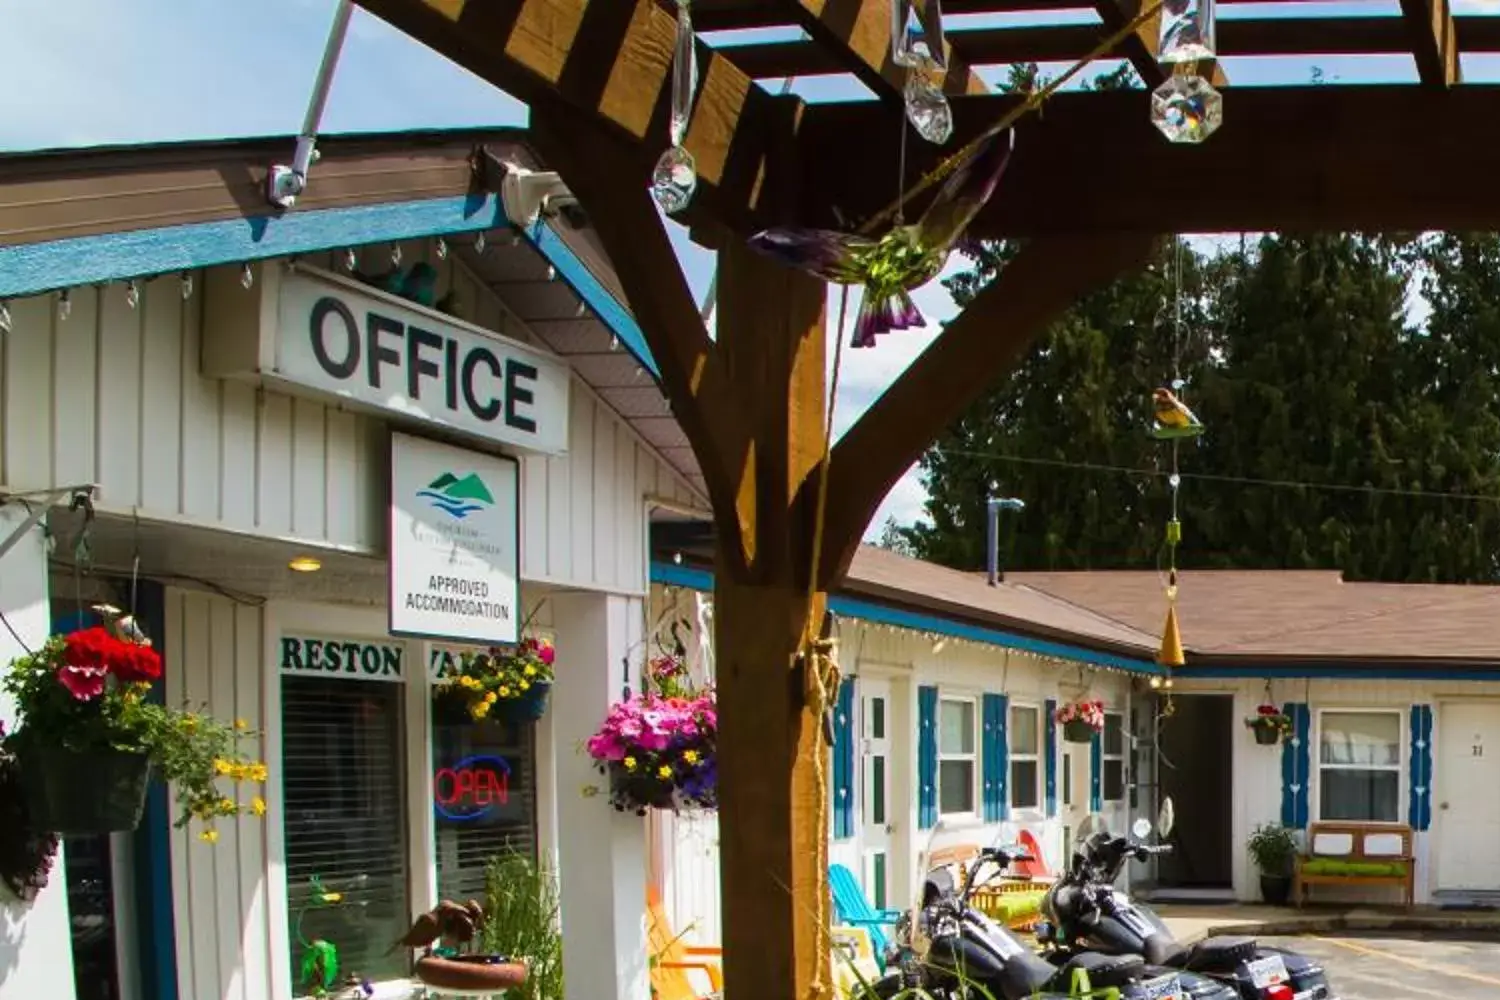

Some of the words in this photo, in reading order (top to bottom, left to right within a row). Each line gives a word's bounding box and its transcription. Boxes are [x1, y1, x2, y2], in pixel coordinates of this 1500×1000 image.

[309, 296, 538, 434] OFFICE
[428, 575, 489, 598] APPROVED
[405, 592, 509, 620] ACCOMMODATION
[434, 767, 509, 805] OPEN
